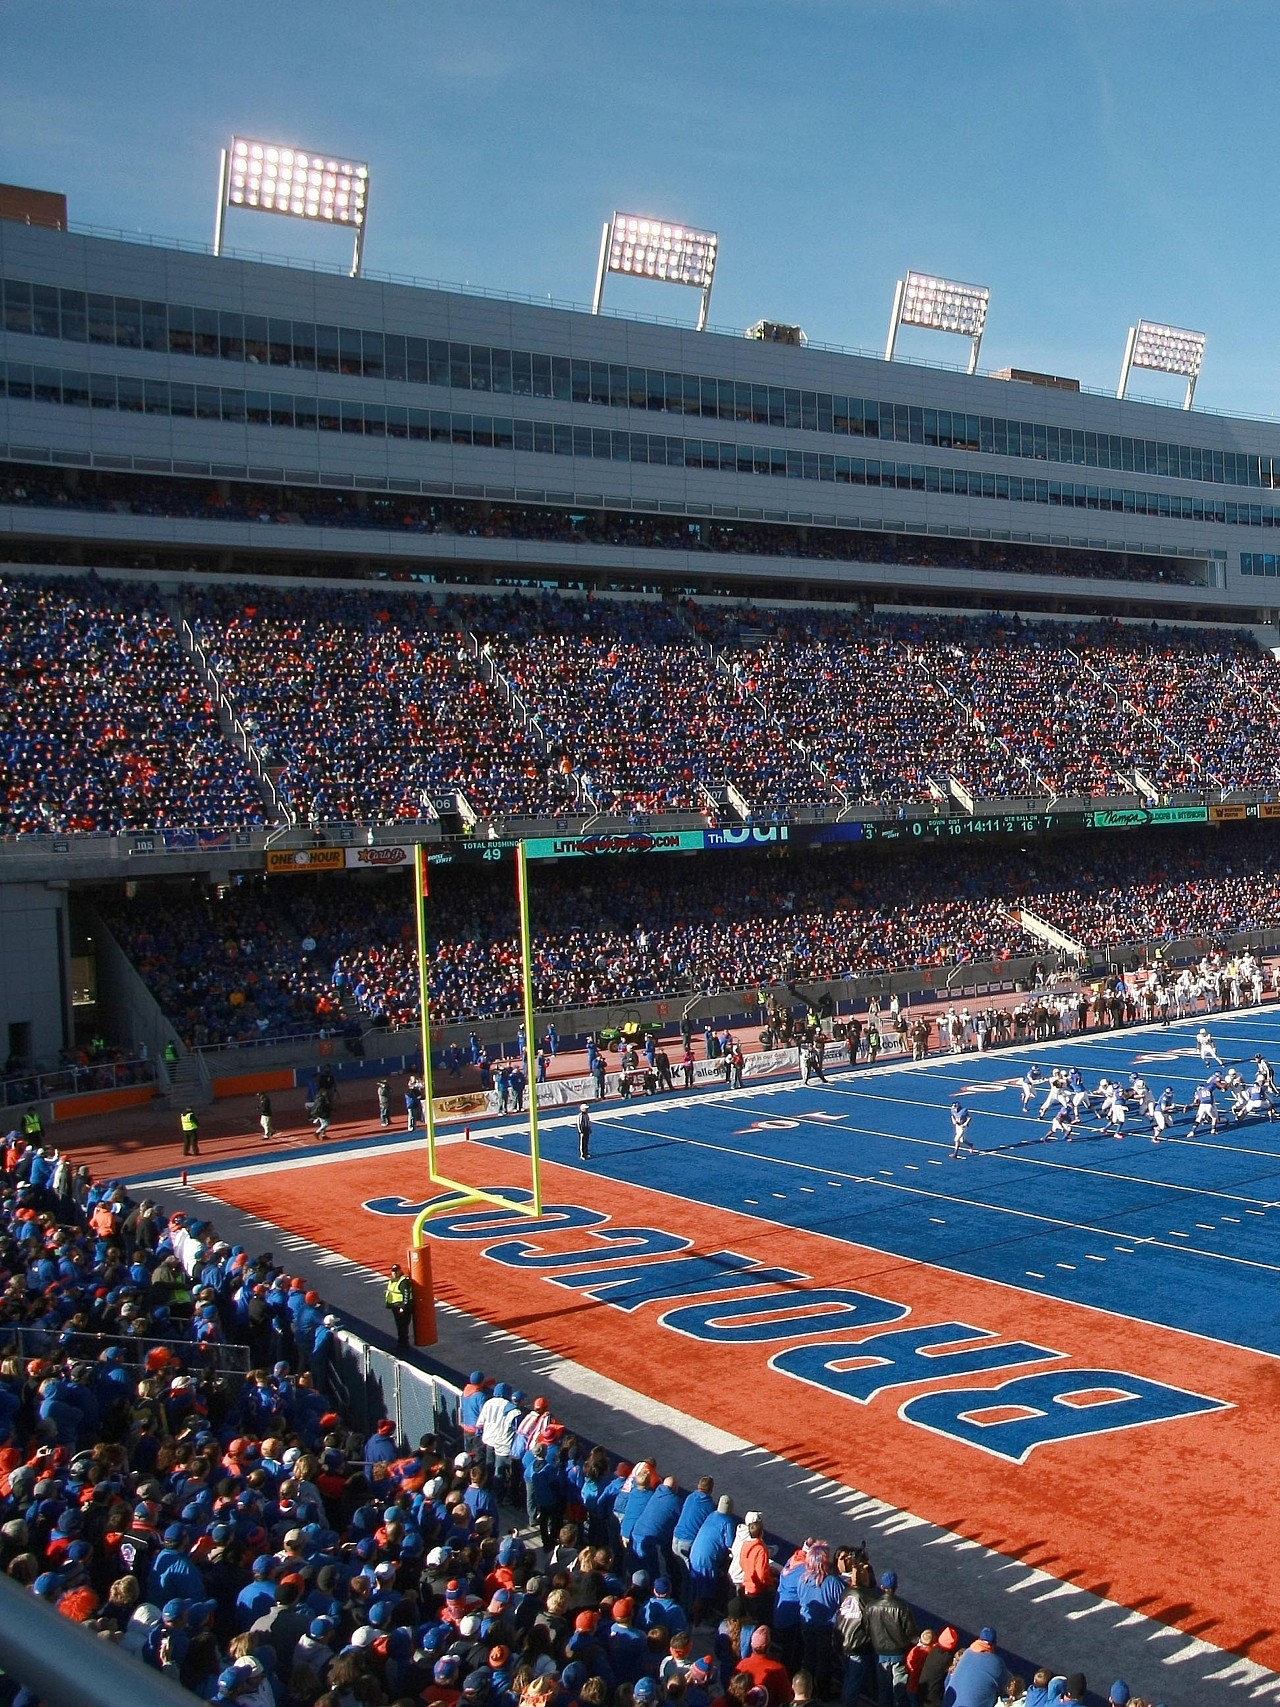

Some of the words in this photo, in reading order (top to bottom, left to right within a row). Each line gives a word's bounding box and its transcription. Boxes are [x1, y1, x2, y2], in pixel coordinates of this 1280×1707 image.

[1246, 806, 1257, 816] CAT
[966, 820, 1000, 832] 14:11
[1006, 822, 1014, 832] 2
[1021, 821, 1033, 831] 16
[1044, 816, 1053, 829] 7
[1086, 818, 1093, 828] 2
[866, 829, 873, 839] 3
[912, 823, 922, 836] 0
[934, 826, 940, 836] 1
[949, 825, 961, 834] 10
[463, 842, 486, 850] TOTAL
[487, 840, 519, 848] RUSHING
[270, 853, 294, 865] ONE
[310, 851, 341, 863] HOUR
[482, 849, 501, 861] 49
[752, 1111, 850, 1129] 10
[361, 1184, 1238, 1467] BRONCOS
